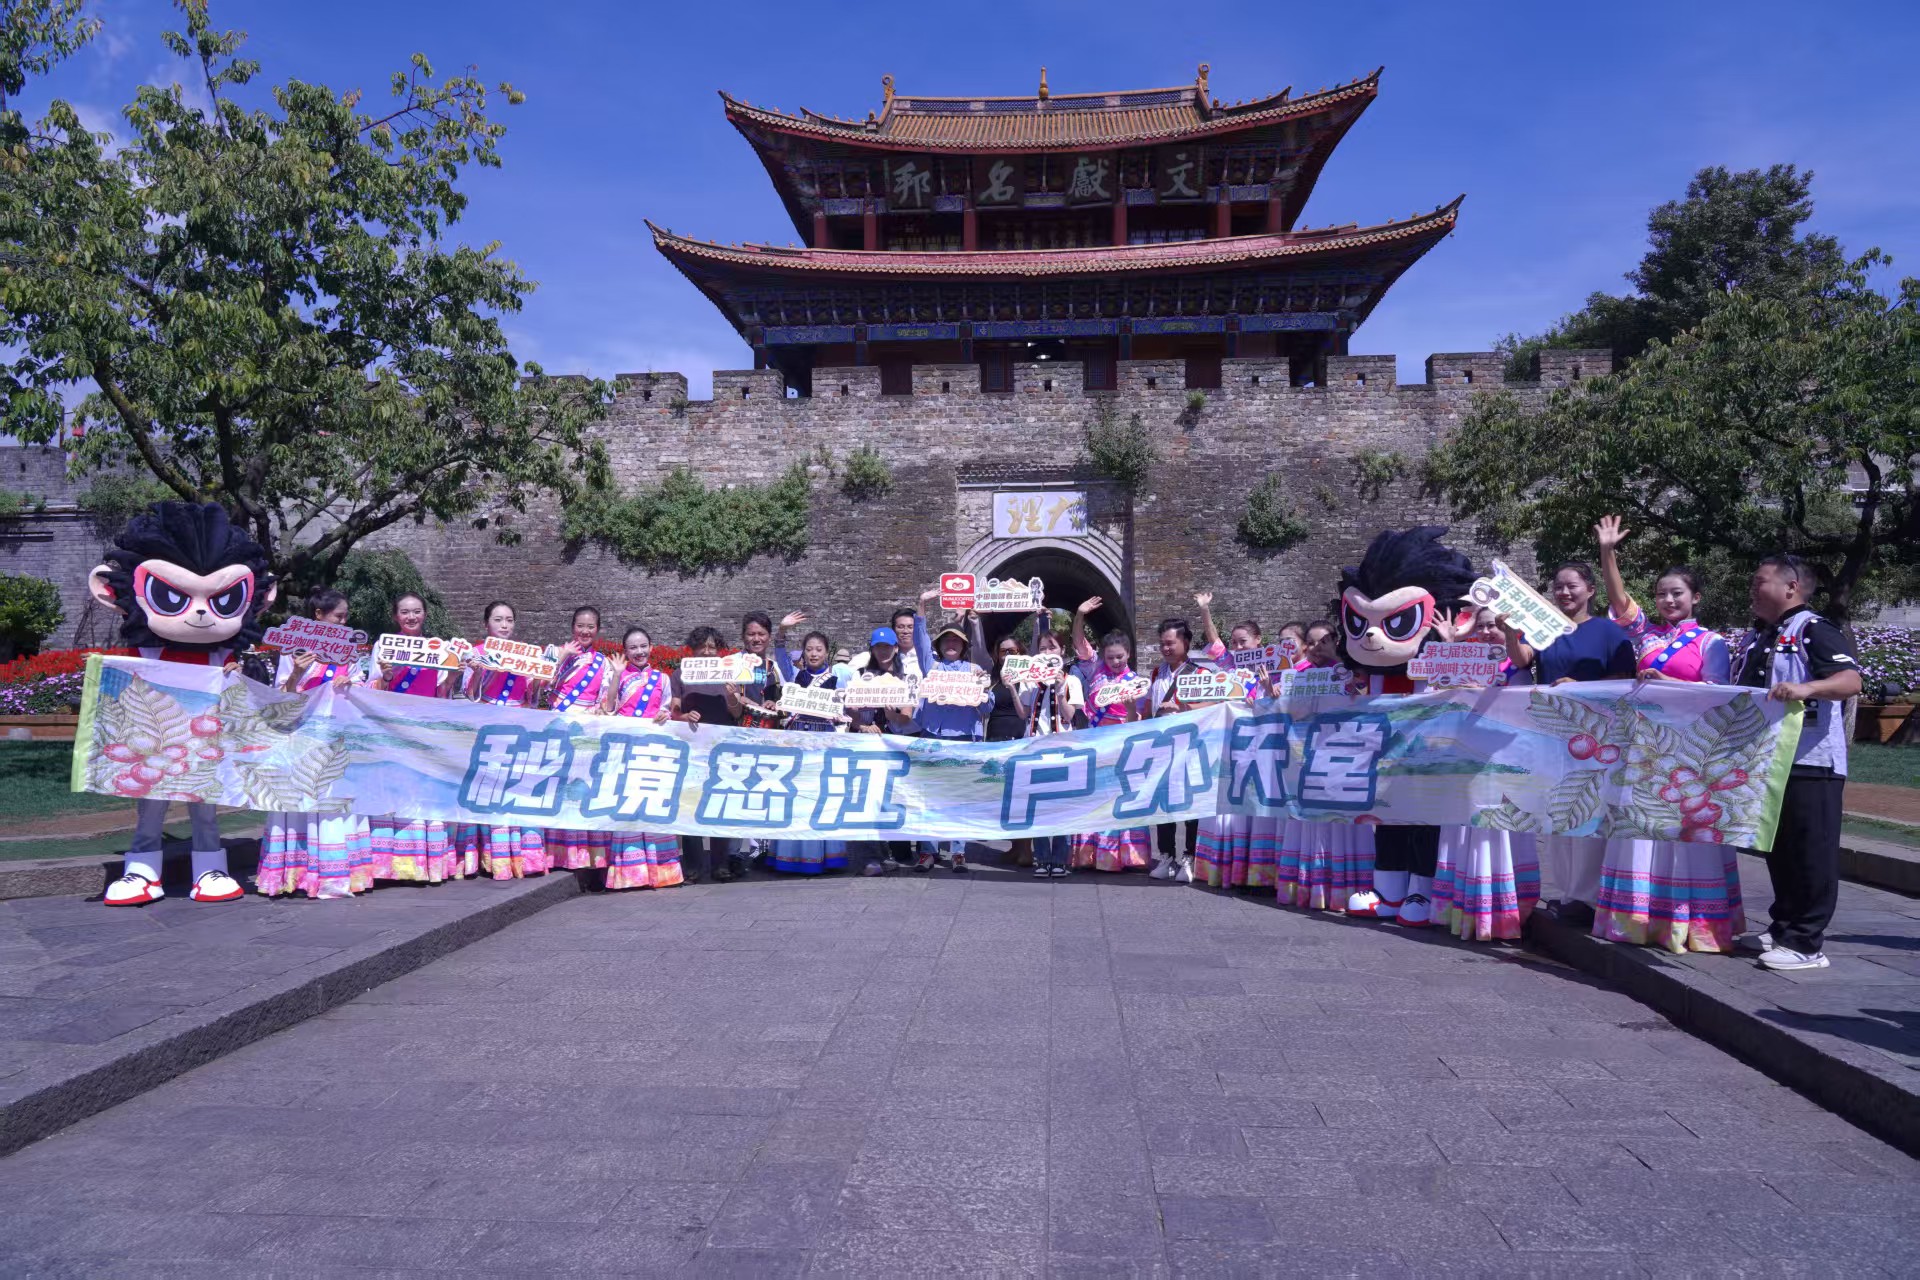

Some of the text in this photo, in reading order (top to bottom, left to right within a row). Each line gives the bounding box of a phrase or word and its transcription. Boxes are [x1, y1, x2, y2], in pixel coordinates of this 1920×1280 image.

[283, 619, 351, 641] 第七届怒江
[267, 631, 354, 658] 精品咖啡文化周
[382, 636, 424, 649] G219
[485, 638, 541, 658] 秘境怒江
[382, 649, 440, 665] 寻咖之旅
[1236, 650, 1263, 663] G219
[1423, 645, 1486, 659] 第七届怒江
[501, 657, 554, 677] 户外天堂
[684, 659, 719, 668] G219
[1006, 658, 1030, 669] 周末
[1019, 664, 1056, 678] 怒江
[1410, 661, 1496, 678] 精品咖啡文化周
[684, 670, 734, 681] 寻咖之旅
[1179, 675, 1212, 686] G219
[786, 685, 831, 701] 有一种叫
[1178, 686, 1226, 698] 寻咖之旅
[784, 697, 841, 714] 云南的生活
[463, 718, 1388, 828] 秘境怒江 户外天堂
